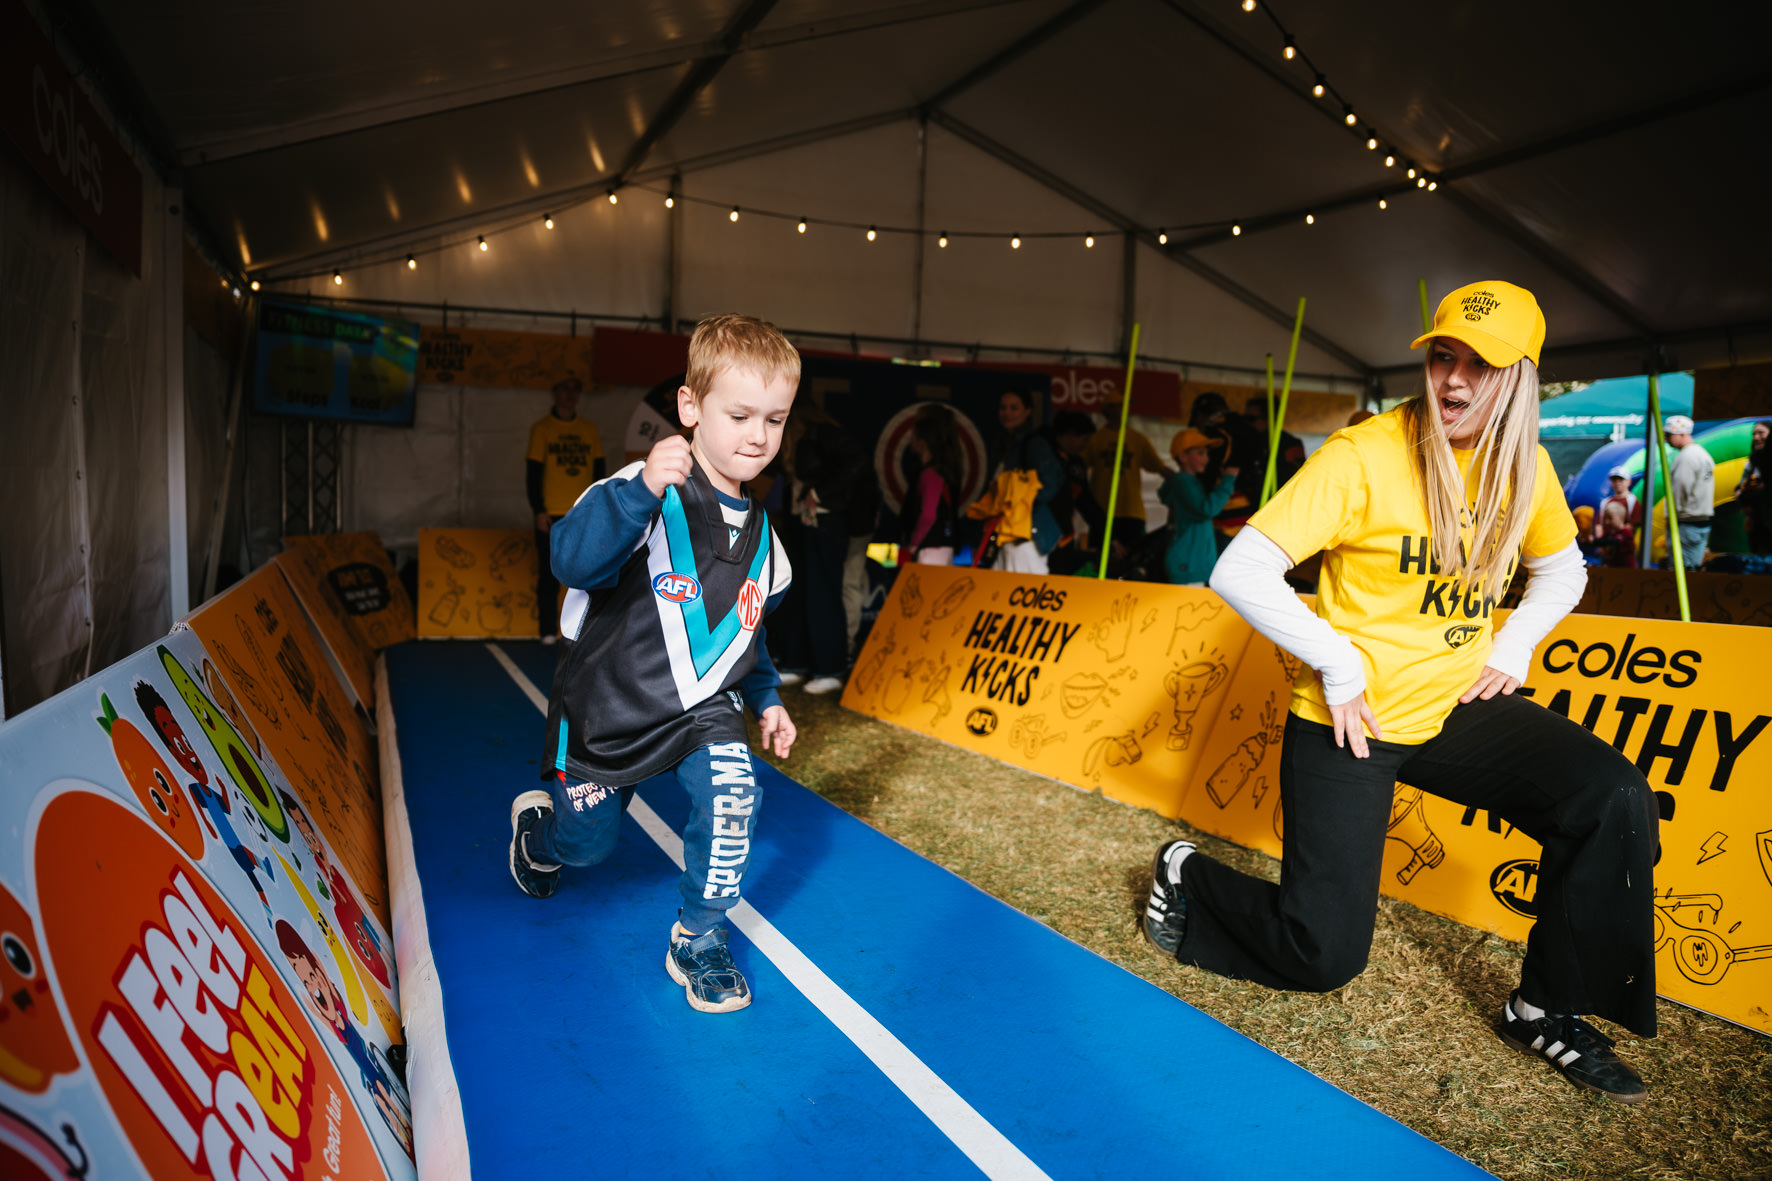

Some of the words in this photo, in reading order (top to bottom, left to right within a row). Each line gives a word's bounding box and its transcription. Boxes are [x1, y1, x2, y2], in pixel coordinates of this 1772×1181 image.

[32, 63, 104, 217] coles
[1461, 296, 1501, 310] HEALTHY
[1463, 304, 1492, 315] KICKS
[1051, 370, 1116, 405] oles
[655, 576, 698, 599] AFL
[739, 581, 760, 627] MG
[1008, 582, 1067, 612] coles
[963, 610, 1082, 663] HEALTHY
[961, 654, 1040, 706] KICKS
[1542, 633, 1702, 688] coles
[566, 782, 602, 801] PROTEC
[573, 798, 585, 812] OF
[585, 791, 607, 809] NEW
[703, 742, 756, 900] SPIDER-MA
[97, 1009, 200, 1165] I
